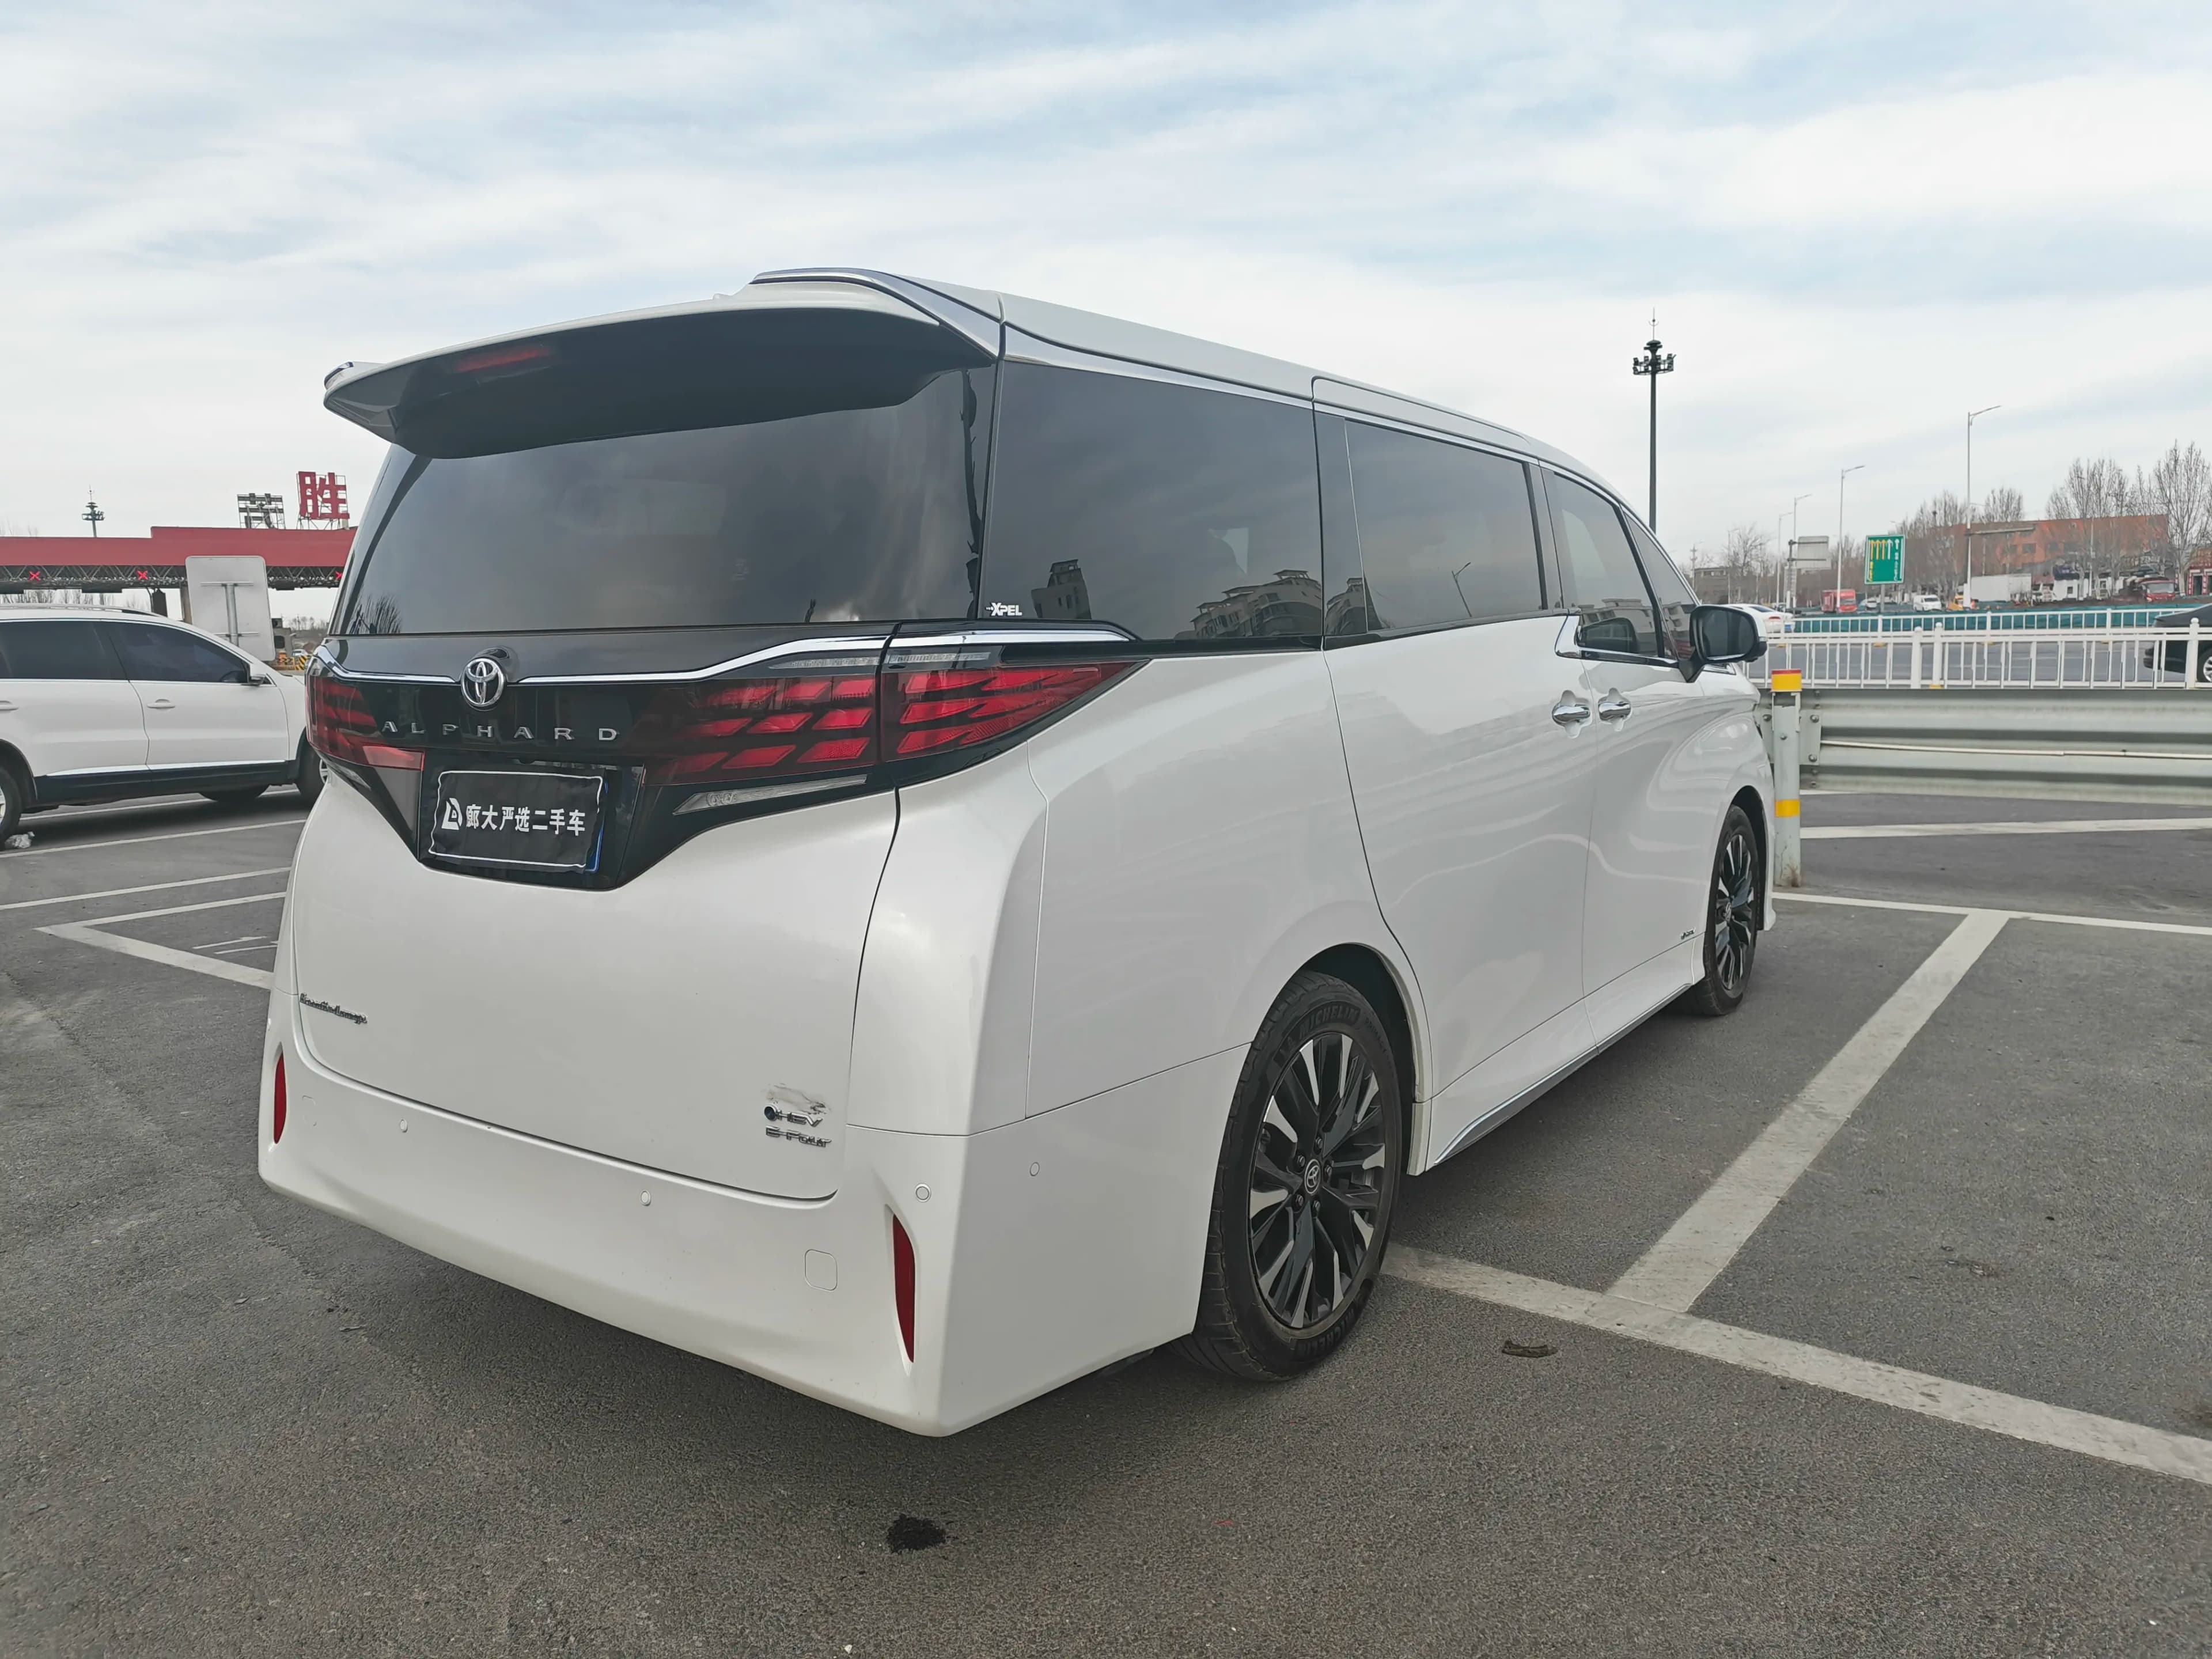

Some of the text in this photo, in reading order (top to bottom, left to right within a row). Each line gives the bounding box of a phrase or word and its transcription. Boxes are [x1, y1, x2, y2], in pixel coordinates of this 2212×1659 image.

[298, 471, 350, 519] 胜
[990, 602, 1022, 616] XPEL
[381, 720, 619, 741] ALPHARD
[465, 804, 586, 836] 廊大严选二手车
